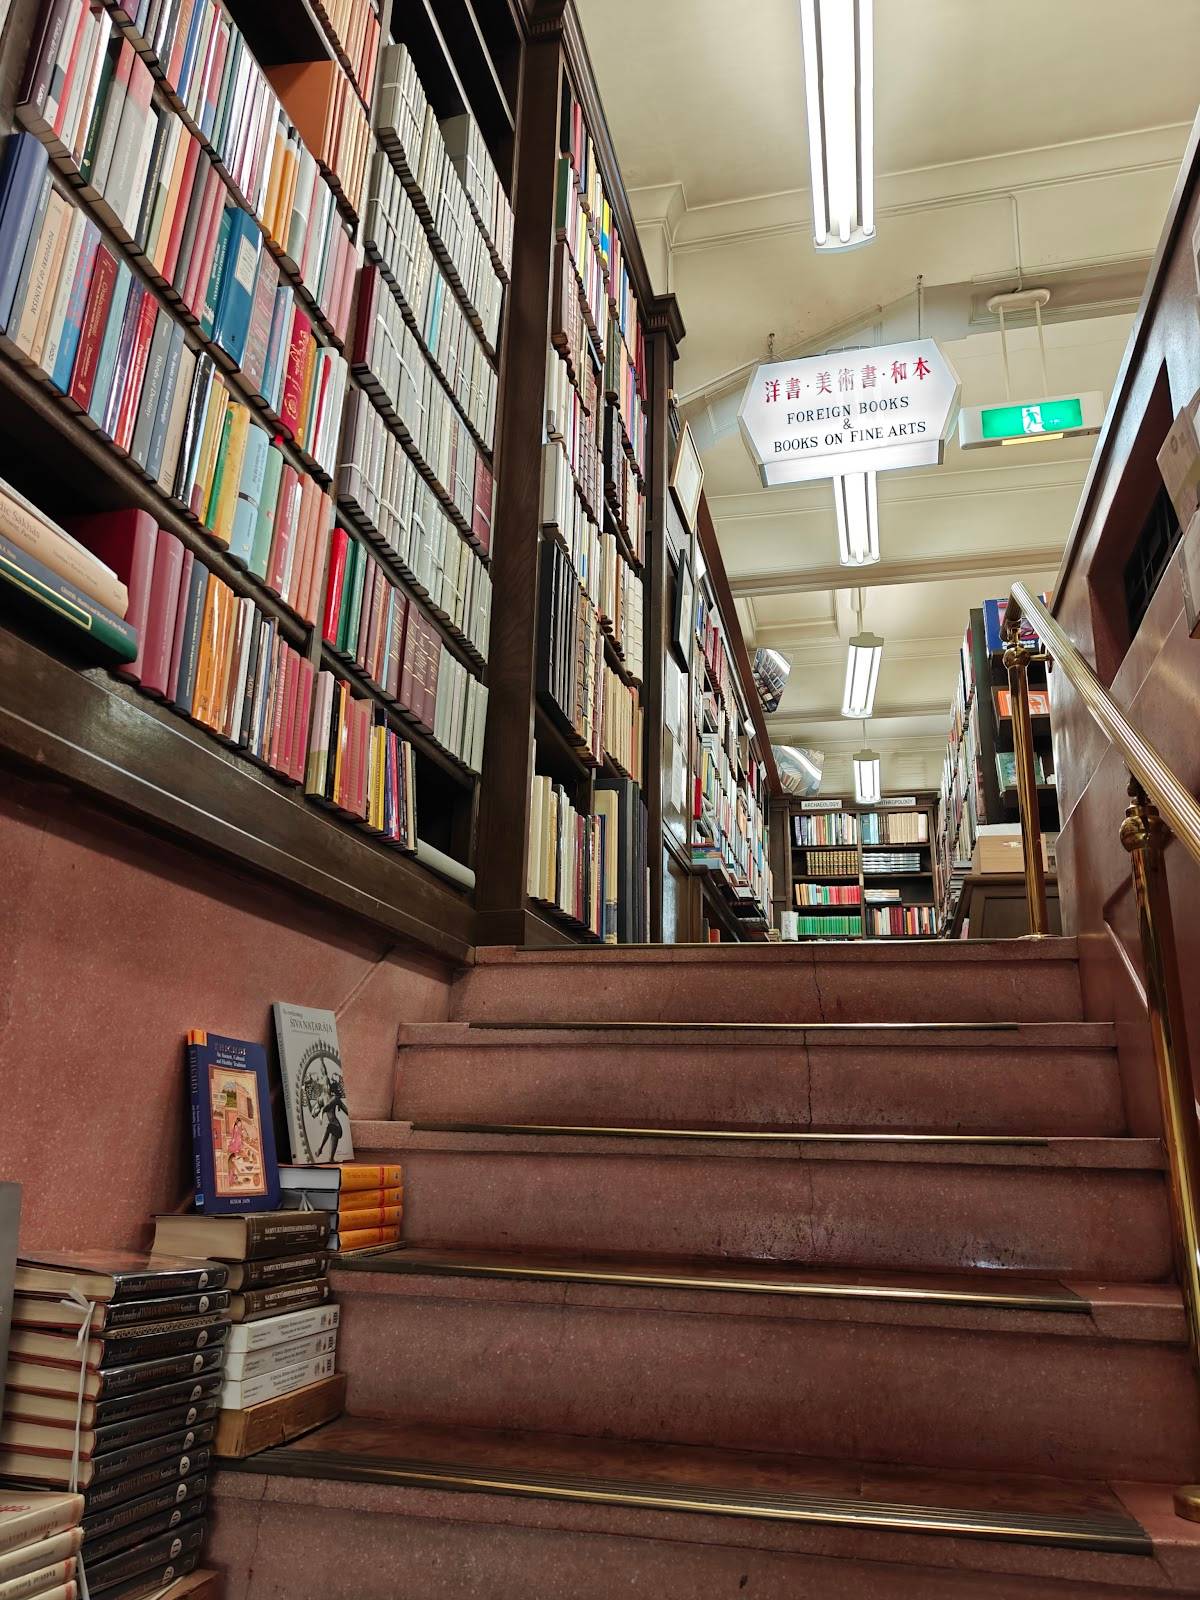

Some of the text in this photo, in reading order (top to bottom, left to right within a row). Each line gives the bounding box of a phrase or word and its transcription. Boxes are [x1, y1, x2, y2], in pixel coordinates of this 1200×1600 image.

[765, 357, 931, 403] 洋書・美術書・和本
[787, 396, 909, 425] FOREIGN BOOKS
[843, 418, 854, 429] &
[774, 421, 926, 453] BOOKS ON FINE ARTS
